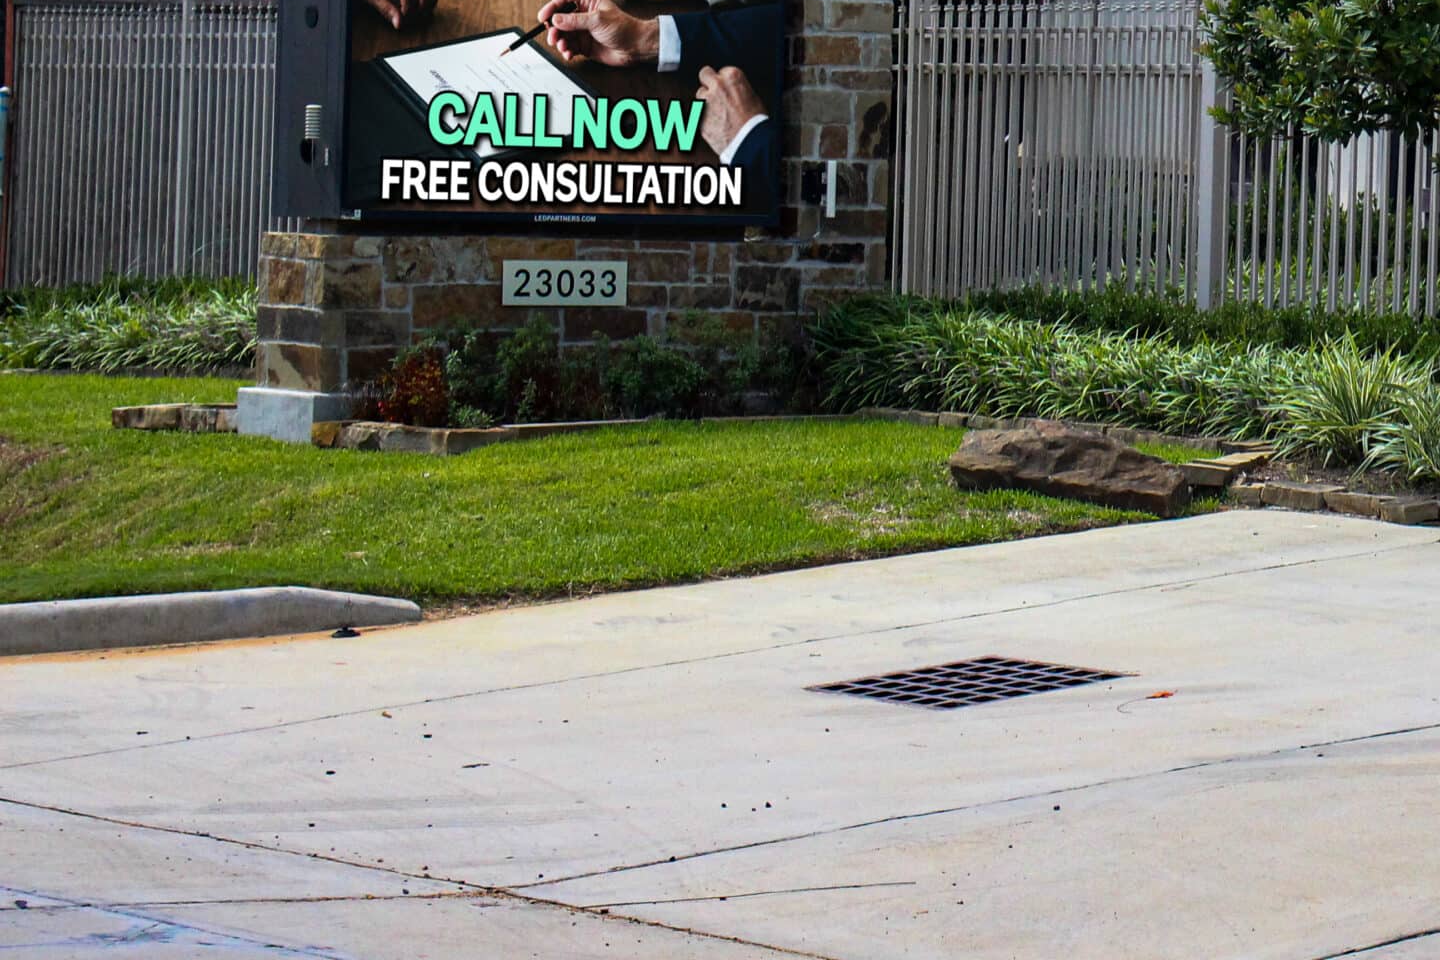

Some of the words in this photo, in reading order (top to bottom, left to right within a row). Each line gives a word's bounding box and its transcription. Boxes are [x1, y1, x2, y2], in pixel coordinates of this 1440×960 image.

[428, 91, 563, 148] CALL
[572, 96, 704, 152] NOW
[381, 158, 471, 201] FREE
[478, 161, 742, 206] CONSULTATION
[513, 268, 617, 298] 23033
